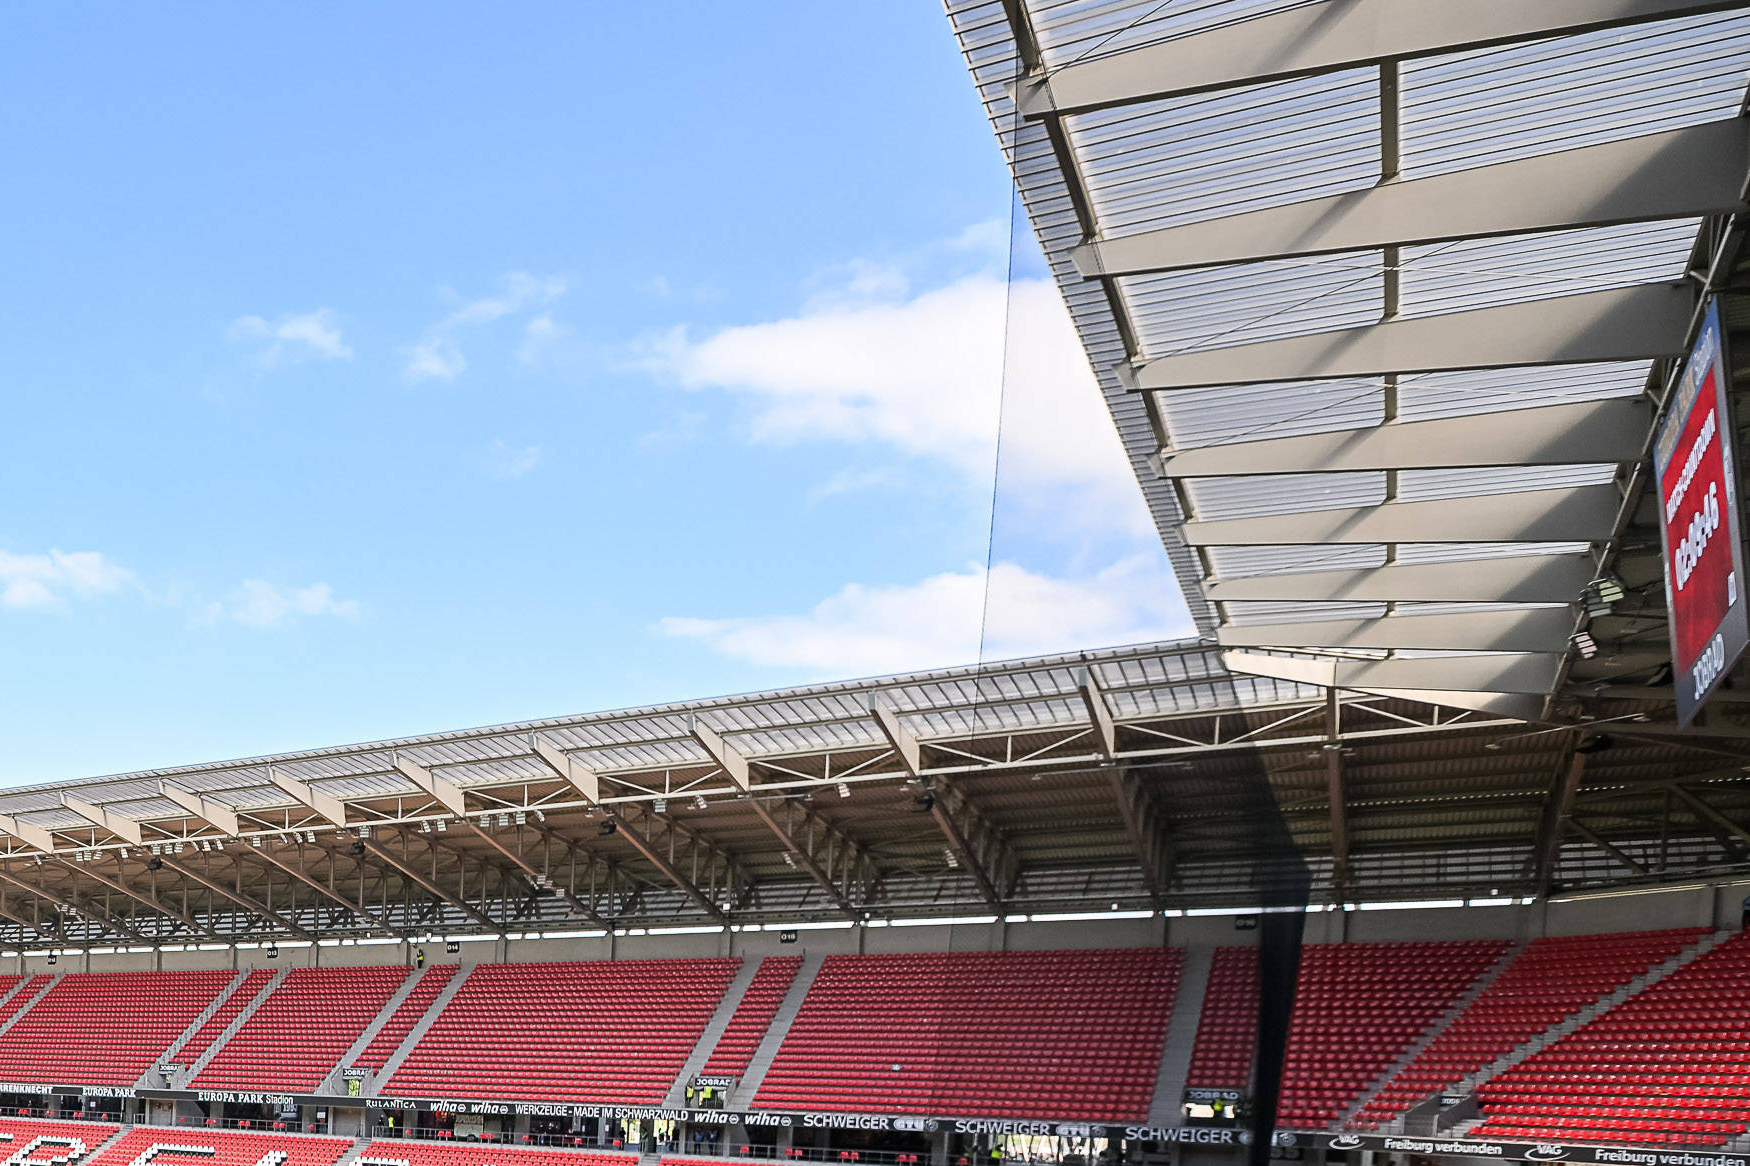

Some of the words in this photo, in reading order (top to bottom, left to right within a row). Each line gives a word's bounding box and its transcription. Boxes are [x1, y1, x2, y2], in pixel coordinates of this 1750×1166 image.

[82, 1087, 113, 1097] EUROPA
[115, 1088, 136, 1098] PARK
[198, 1092, 235, 1103] EUROPA
[238, 1093, 264, 1104] PARK
[265, 1094, 294, 1105] Stadion
[366, 1099, 416, 1109] RULANTICA
[430, 1101, 457, 1112] wiha
[471, 1102, 499, 1114] wiha
[515, 1104, 568, 1117] WERKZEUGE
[573, 1107, 600, 1118] MADE
[602, 1108, 613, 1118] IM
[614, 1108, 688, 1122] SCHWARZWALD
[694, 1111, 729, 1124] wiha
[744, 1112, 780, 1126] wiha
[803, 1114, 889, 1130] SCHWEIGER
[955, 1119, 1050, 1136] SCHWEIGER
[1125, 1126, 1233, 1144] SCHWEIGER
[1339, 1135, 1360, 1145] VAG
[1384, 1138, 1433, 1155] Freiburg
[1435, 1141, 1503, 1156] verbunden
[1536, 1144, 1562, 1156] VAG
